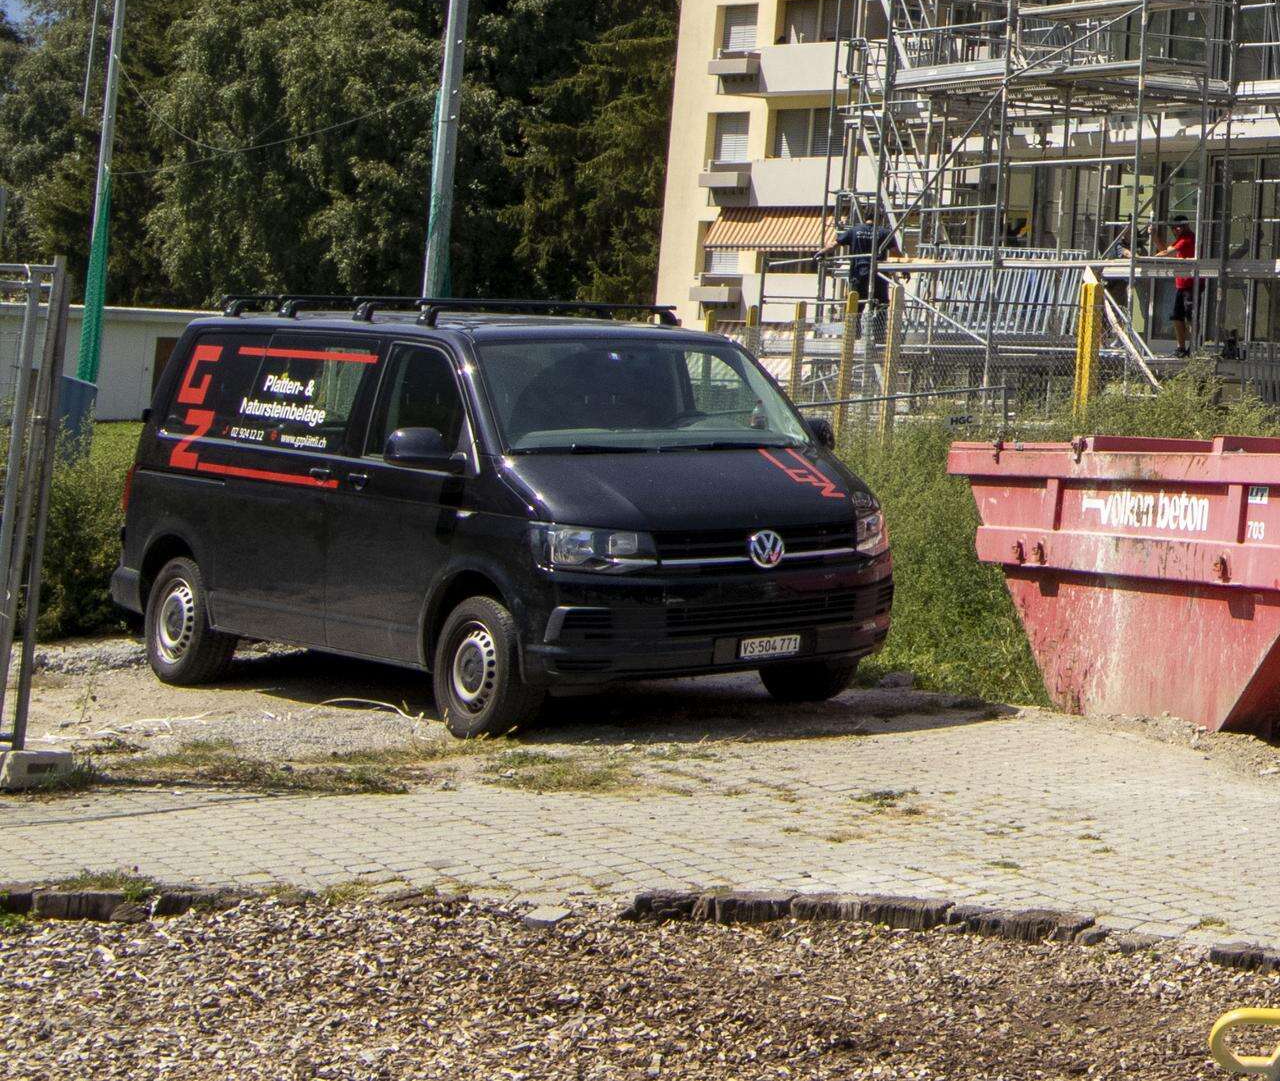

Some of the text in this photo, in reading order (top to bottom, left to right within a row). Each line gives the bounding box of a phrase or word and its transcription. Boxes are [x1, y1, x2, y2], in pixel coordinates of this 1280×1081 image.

[263, 374, 315, 397] Platten- &
[240, 397, 326, 427] Natursteinbeläge
[1157, 489, 1210, 531] beton
[1247, 521, 1265, 540] 703
